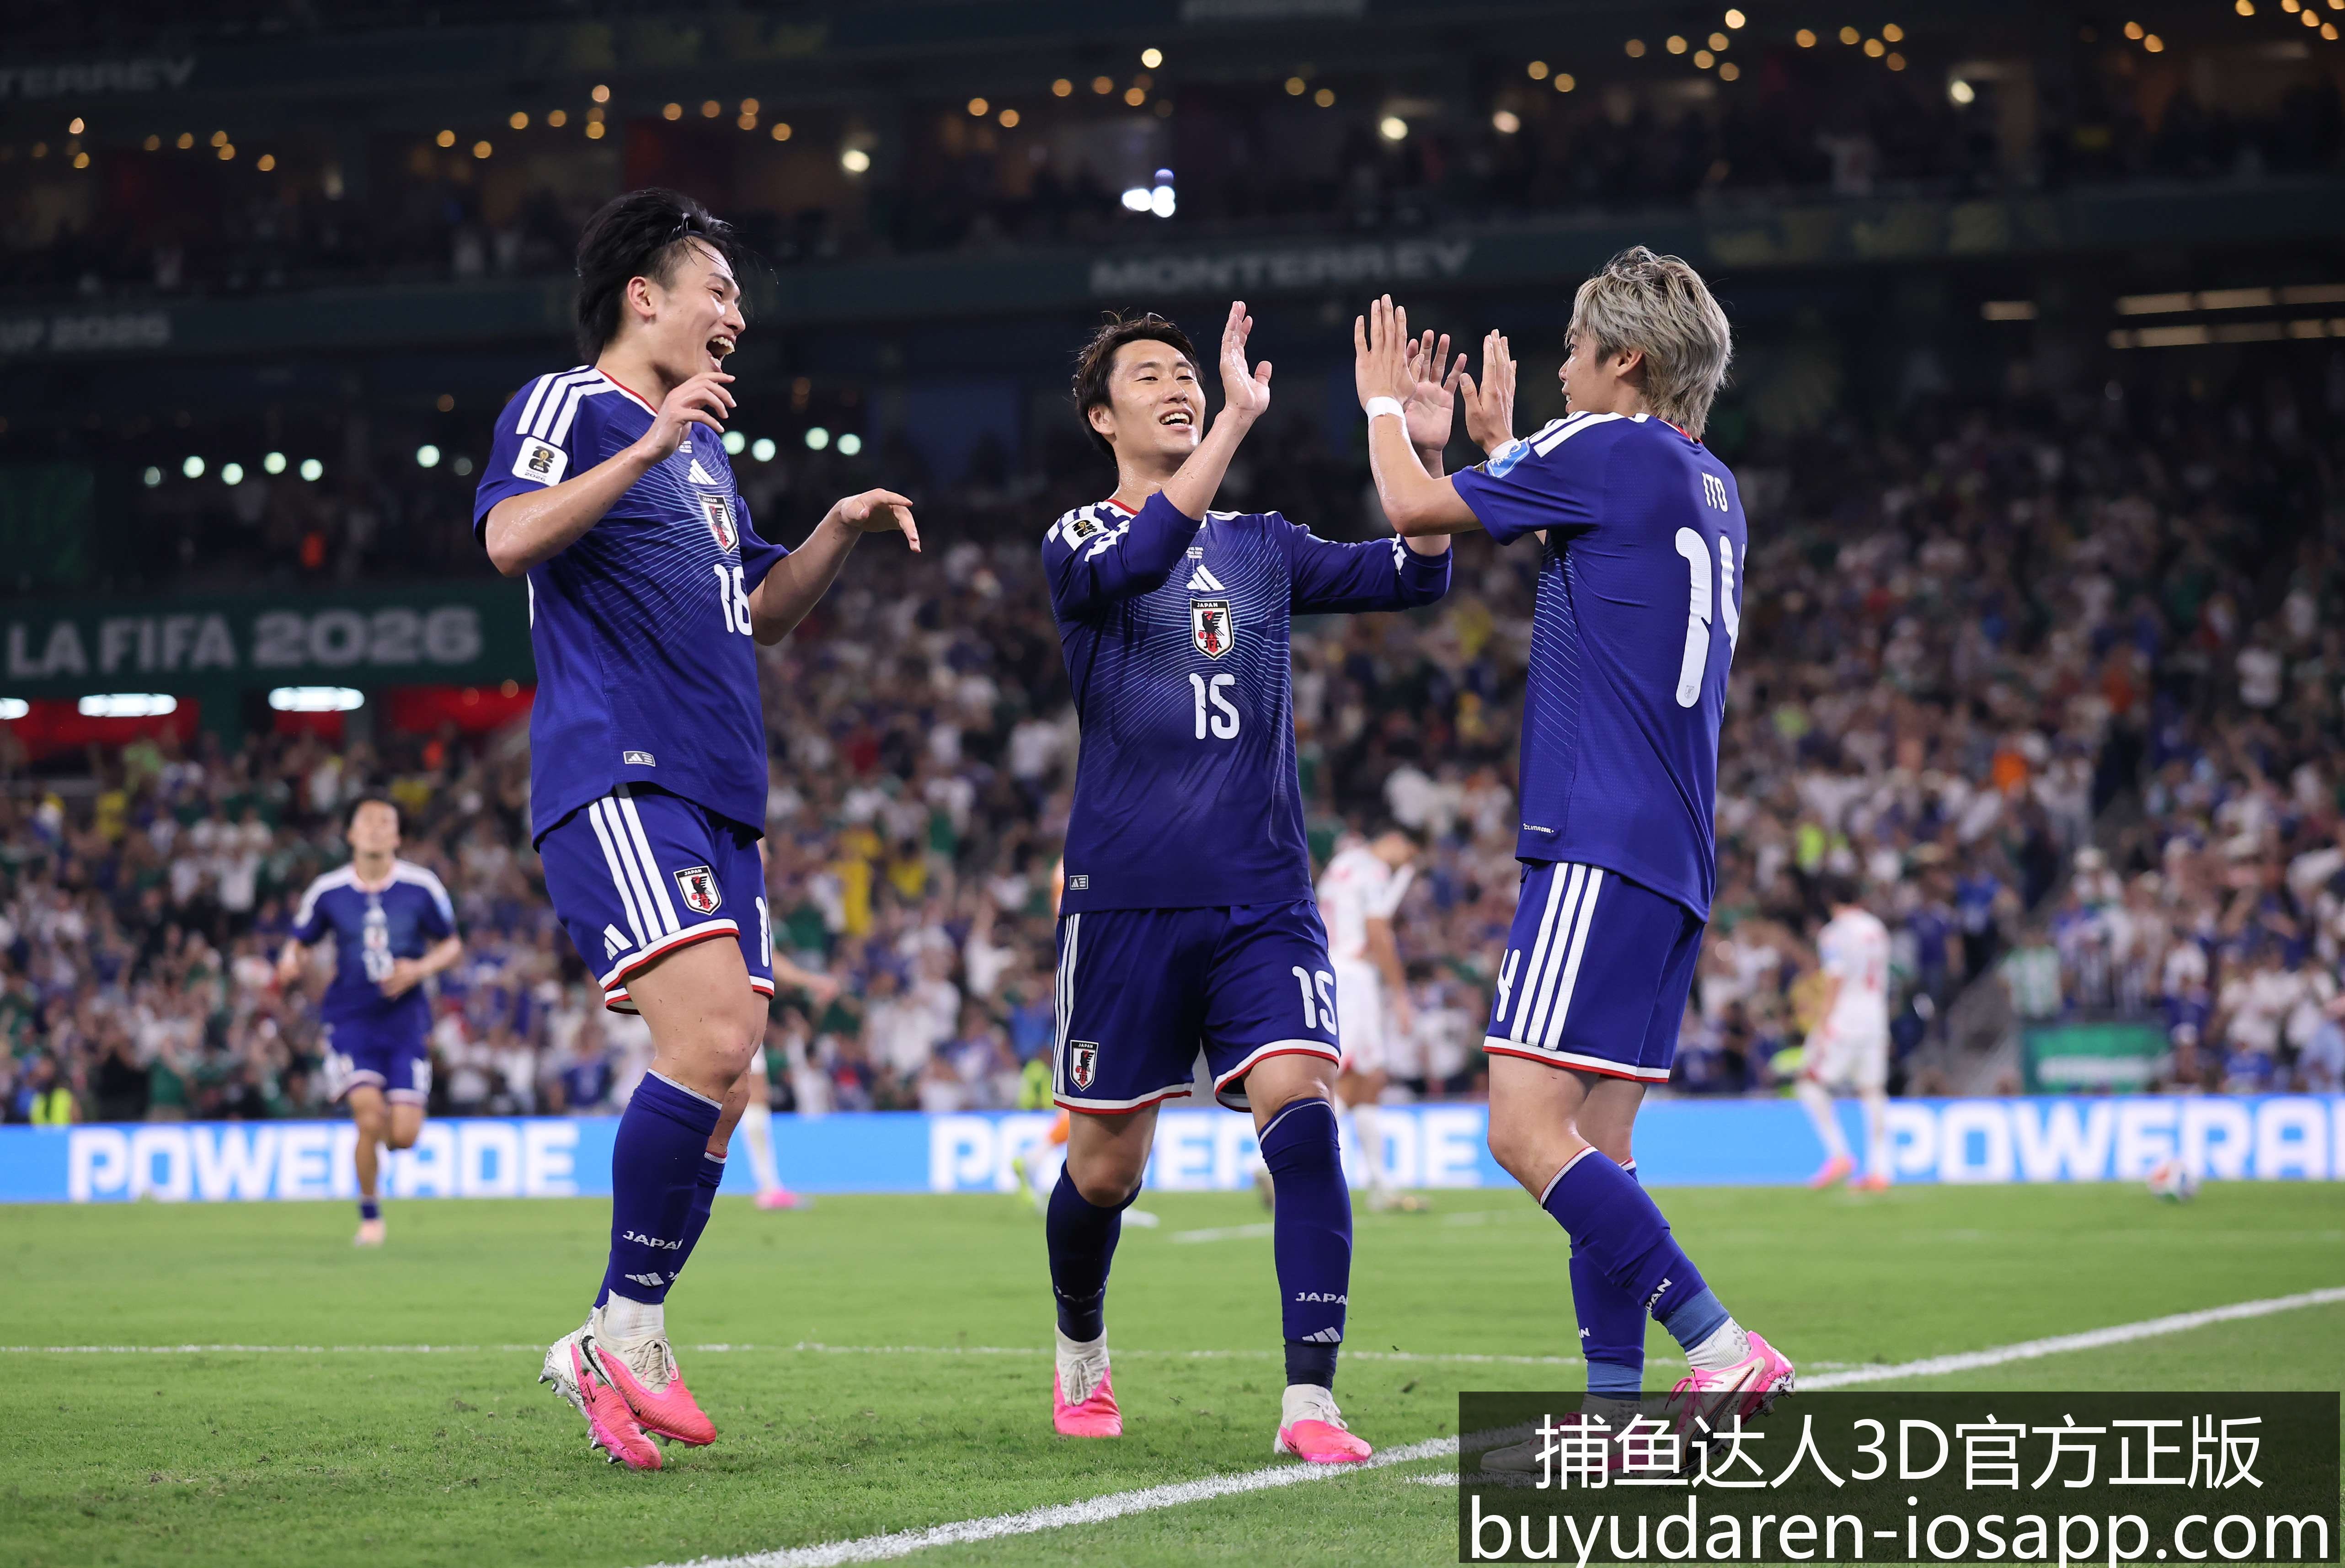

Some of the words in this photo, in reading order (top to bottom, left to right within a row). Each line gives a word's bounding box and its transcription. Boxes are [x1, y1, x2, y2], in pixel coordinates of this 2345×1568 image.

[1090, 240, 1471, 295] MONTERREY
[524, 472, 545, 482] 2026
[1702, 472, 1728, 512] ITO
[7, 619, 88, 680] LA
[99, 613, 237, 674] FIFA
[252, 604, 483, 669] 2026
[1203, 640, 1223, 649] JFA
[1189, 673, 1240, 740] 15
[1524, 825, 1551, 833] CLIMACOOL
[755, 896, 773, 967] 1
[1292, 965, 1337, 1036] 15
[928, 1109, 1484, 1193] POERDE
[1880, 1099, 2345, 1184] POWERA
[1295, 1292, 1348, 1306] JAPA
